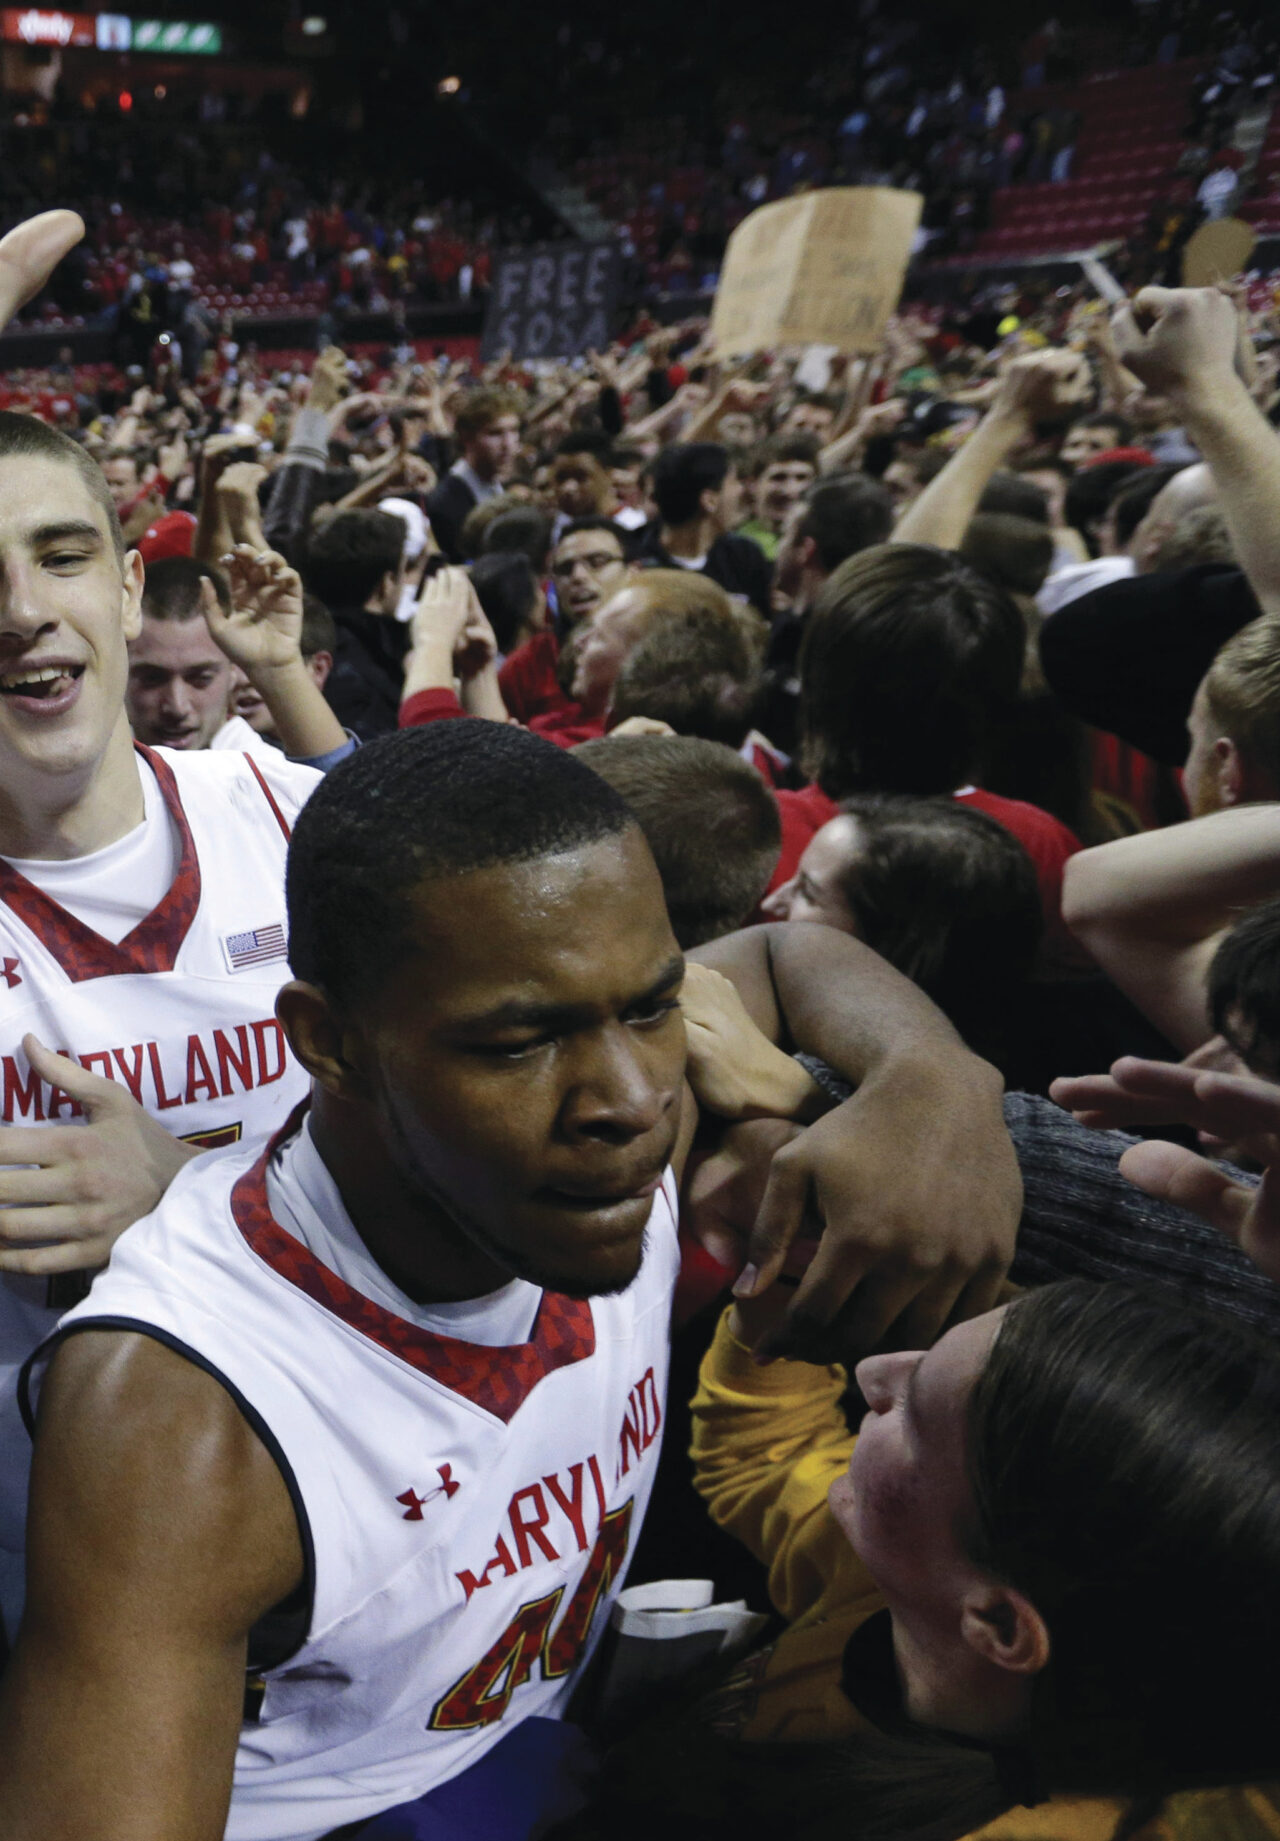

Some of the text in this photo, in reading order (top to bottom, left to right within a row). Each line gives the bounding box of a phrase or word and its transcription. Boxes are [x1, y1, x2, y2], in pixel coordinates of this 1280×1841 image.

[498, 247, 611, 308] FREE
[496, 311, 608, 357] SOSA
[455, 1366, 661, 1604] ARYLND
